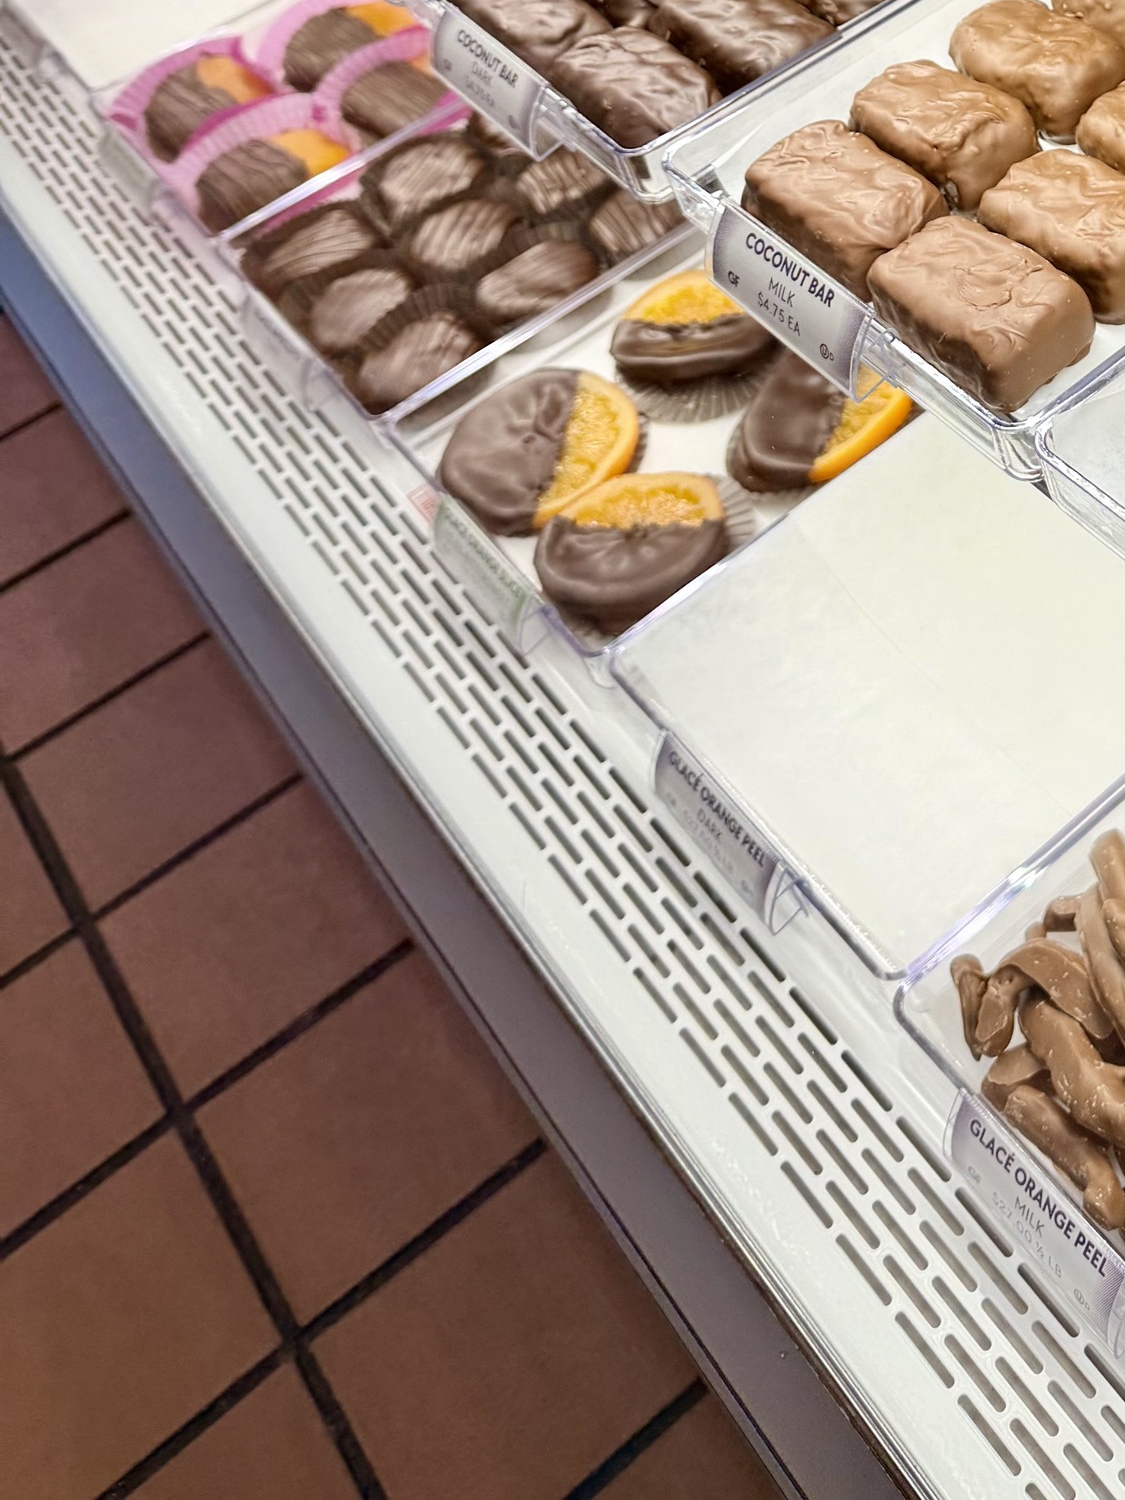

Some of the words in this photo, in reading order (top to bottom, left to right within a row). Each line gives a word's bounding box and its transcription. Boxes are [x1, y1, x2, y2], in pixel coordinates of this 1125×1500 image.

[457, 29, 501, 73] COCONUT
[498, 63, 519, 89] BAR
[727, 270, 740, 288] GF
[745, 232, 810, 287] COCONUT
[808, 277, 835, 308] BAR
[768, 277, 796, 309] MILK
[757, 291, 785, 324] $4.75
[788, 318, 801, 337] EA
[699, 785, 744, 840] ORANGE
[740, 835, 765, 868] PEEL
[970, 1118, 1015, 1174] GLACÉ
[1014, 1167, 1076, 1240] ORANGE
[1074, 1231, 1107, 1278] PEEL
[1014, 1195, 1046, 1239] MILK
[1048, 1255, 1062, 1279] LB
